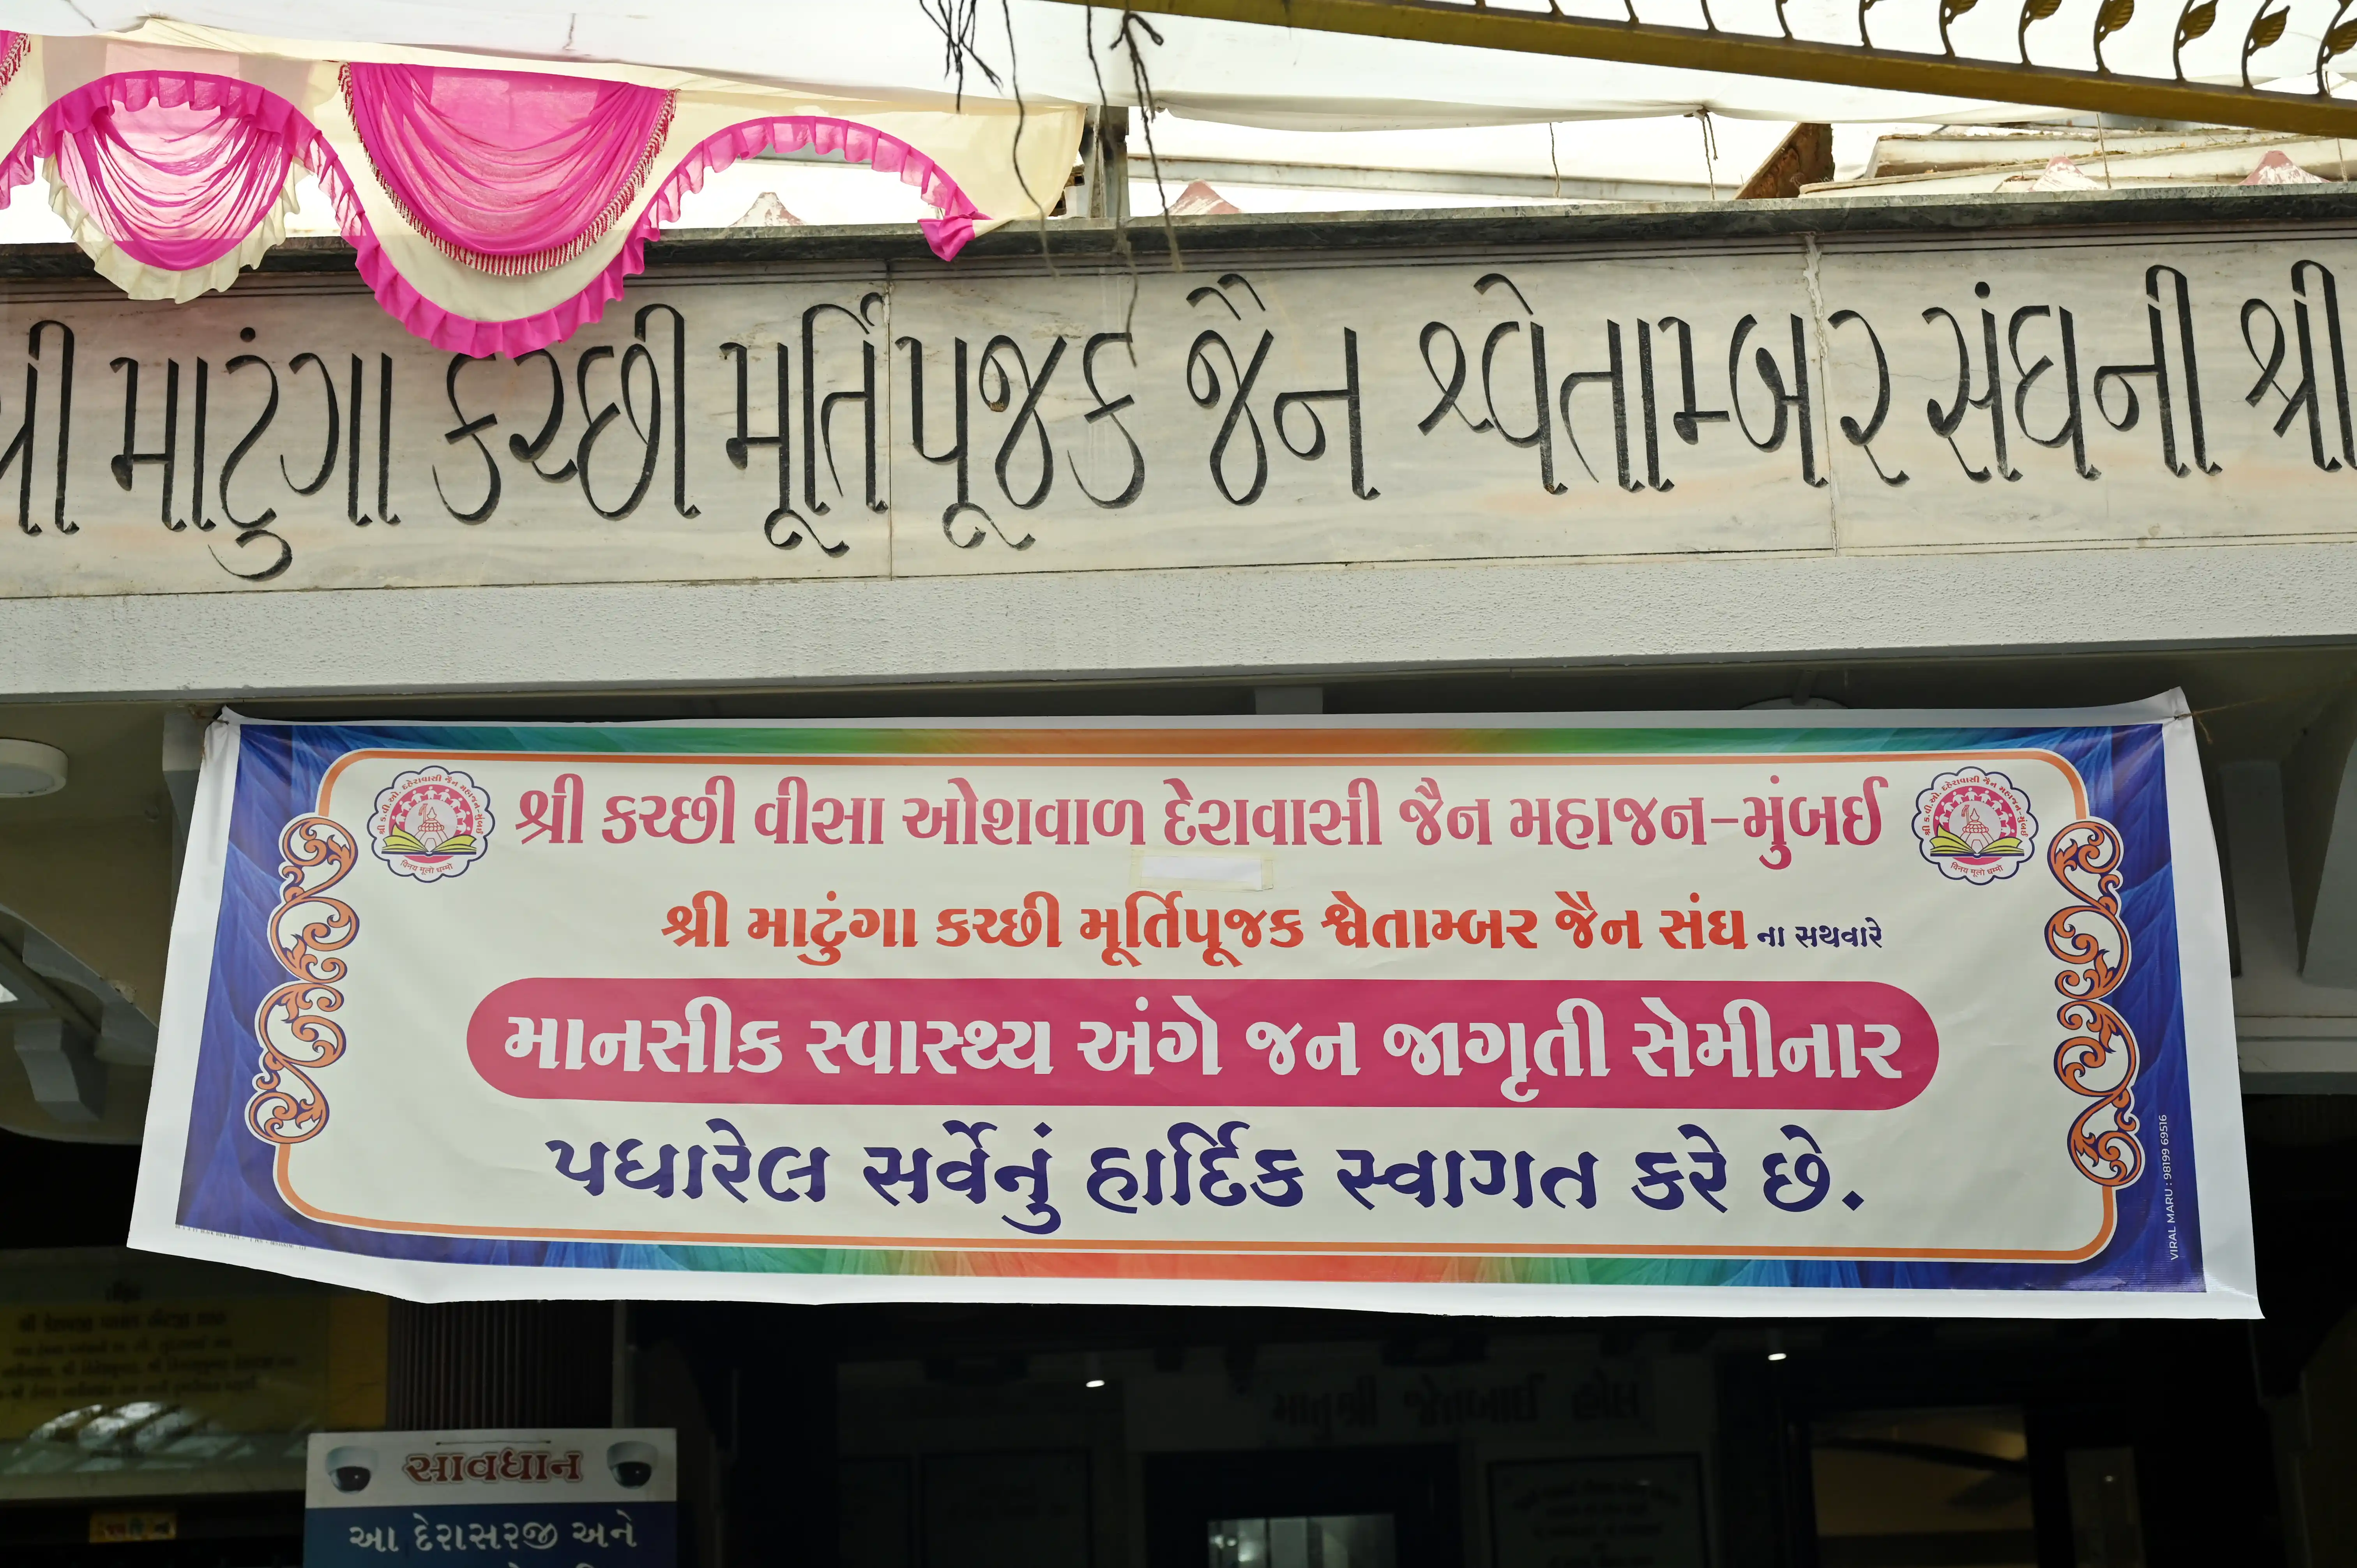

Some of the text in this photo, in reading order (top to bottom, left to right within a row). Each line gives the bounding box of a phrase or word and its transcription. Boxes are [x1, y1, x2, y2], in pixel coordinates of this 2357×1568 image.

[110, 327, 401, 582] માટુંગા
[1186, 274, 1381, 509] જૈન
[1922, 265, 2223, 483] સંઘની
[2240, 260, 2357, 473] શ્રી
[516, 773, 584, 844] શ્રી
[602, 775, 735, 844] કચ્છી
[755, 777, 885, 844] વીસા
[903, 778, 1145, 845] ઓશવાળ
[1164, 778, 1382, 846] દેરાવાસી
[1401, 778, 1492, 845] જૈન
[400, 860, 453, 875] विनय मूलो धम्मो
[1951, 862, 2004, 878] विनय मूलो धम्मो
[662, 890, 1882, 968] શ્રી માટુંગા કચ્છી મૂર્તિપૂજક શ્વેતામ્બર જૈન સંઘ ના સથવારે
[504, 995, 1902, 1102] માનસીક સ્વાસ્થ્ય અંગે જન જાગૃતી સેમીનાર
[2158, 1114, 2169, 1146] 69516
[545, 1118, 1864, 1235] પધારેલ સર્વેનું હાર્દિક સ્વાગત કરે છે.
[2162, 1148, 2172, 1180] 98199
[2164, 1188, 2176, 1224] MARU
[2167, 1226, 2179, 1261] VIRAL
[404, 1449, 582, 1482] સાવધાન
[349, 1510, 637, 1552] આ દેરાસરજી અને
